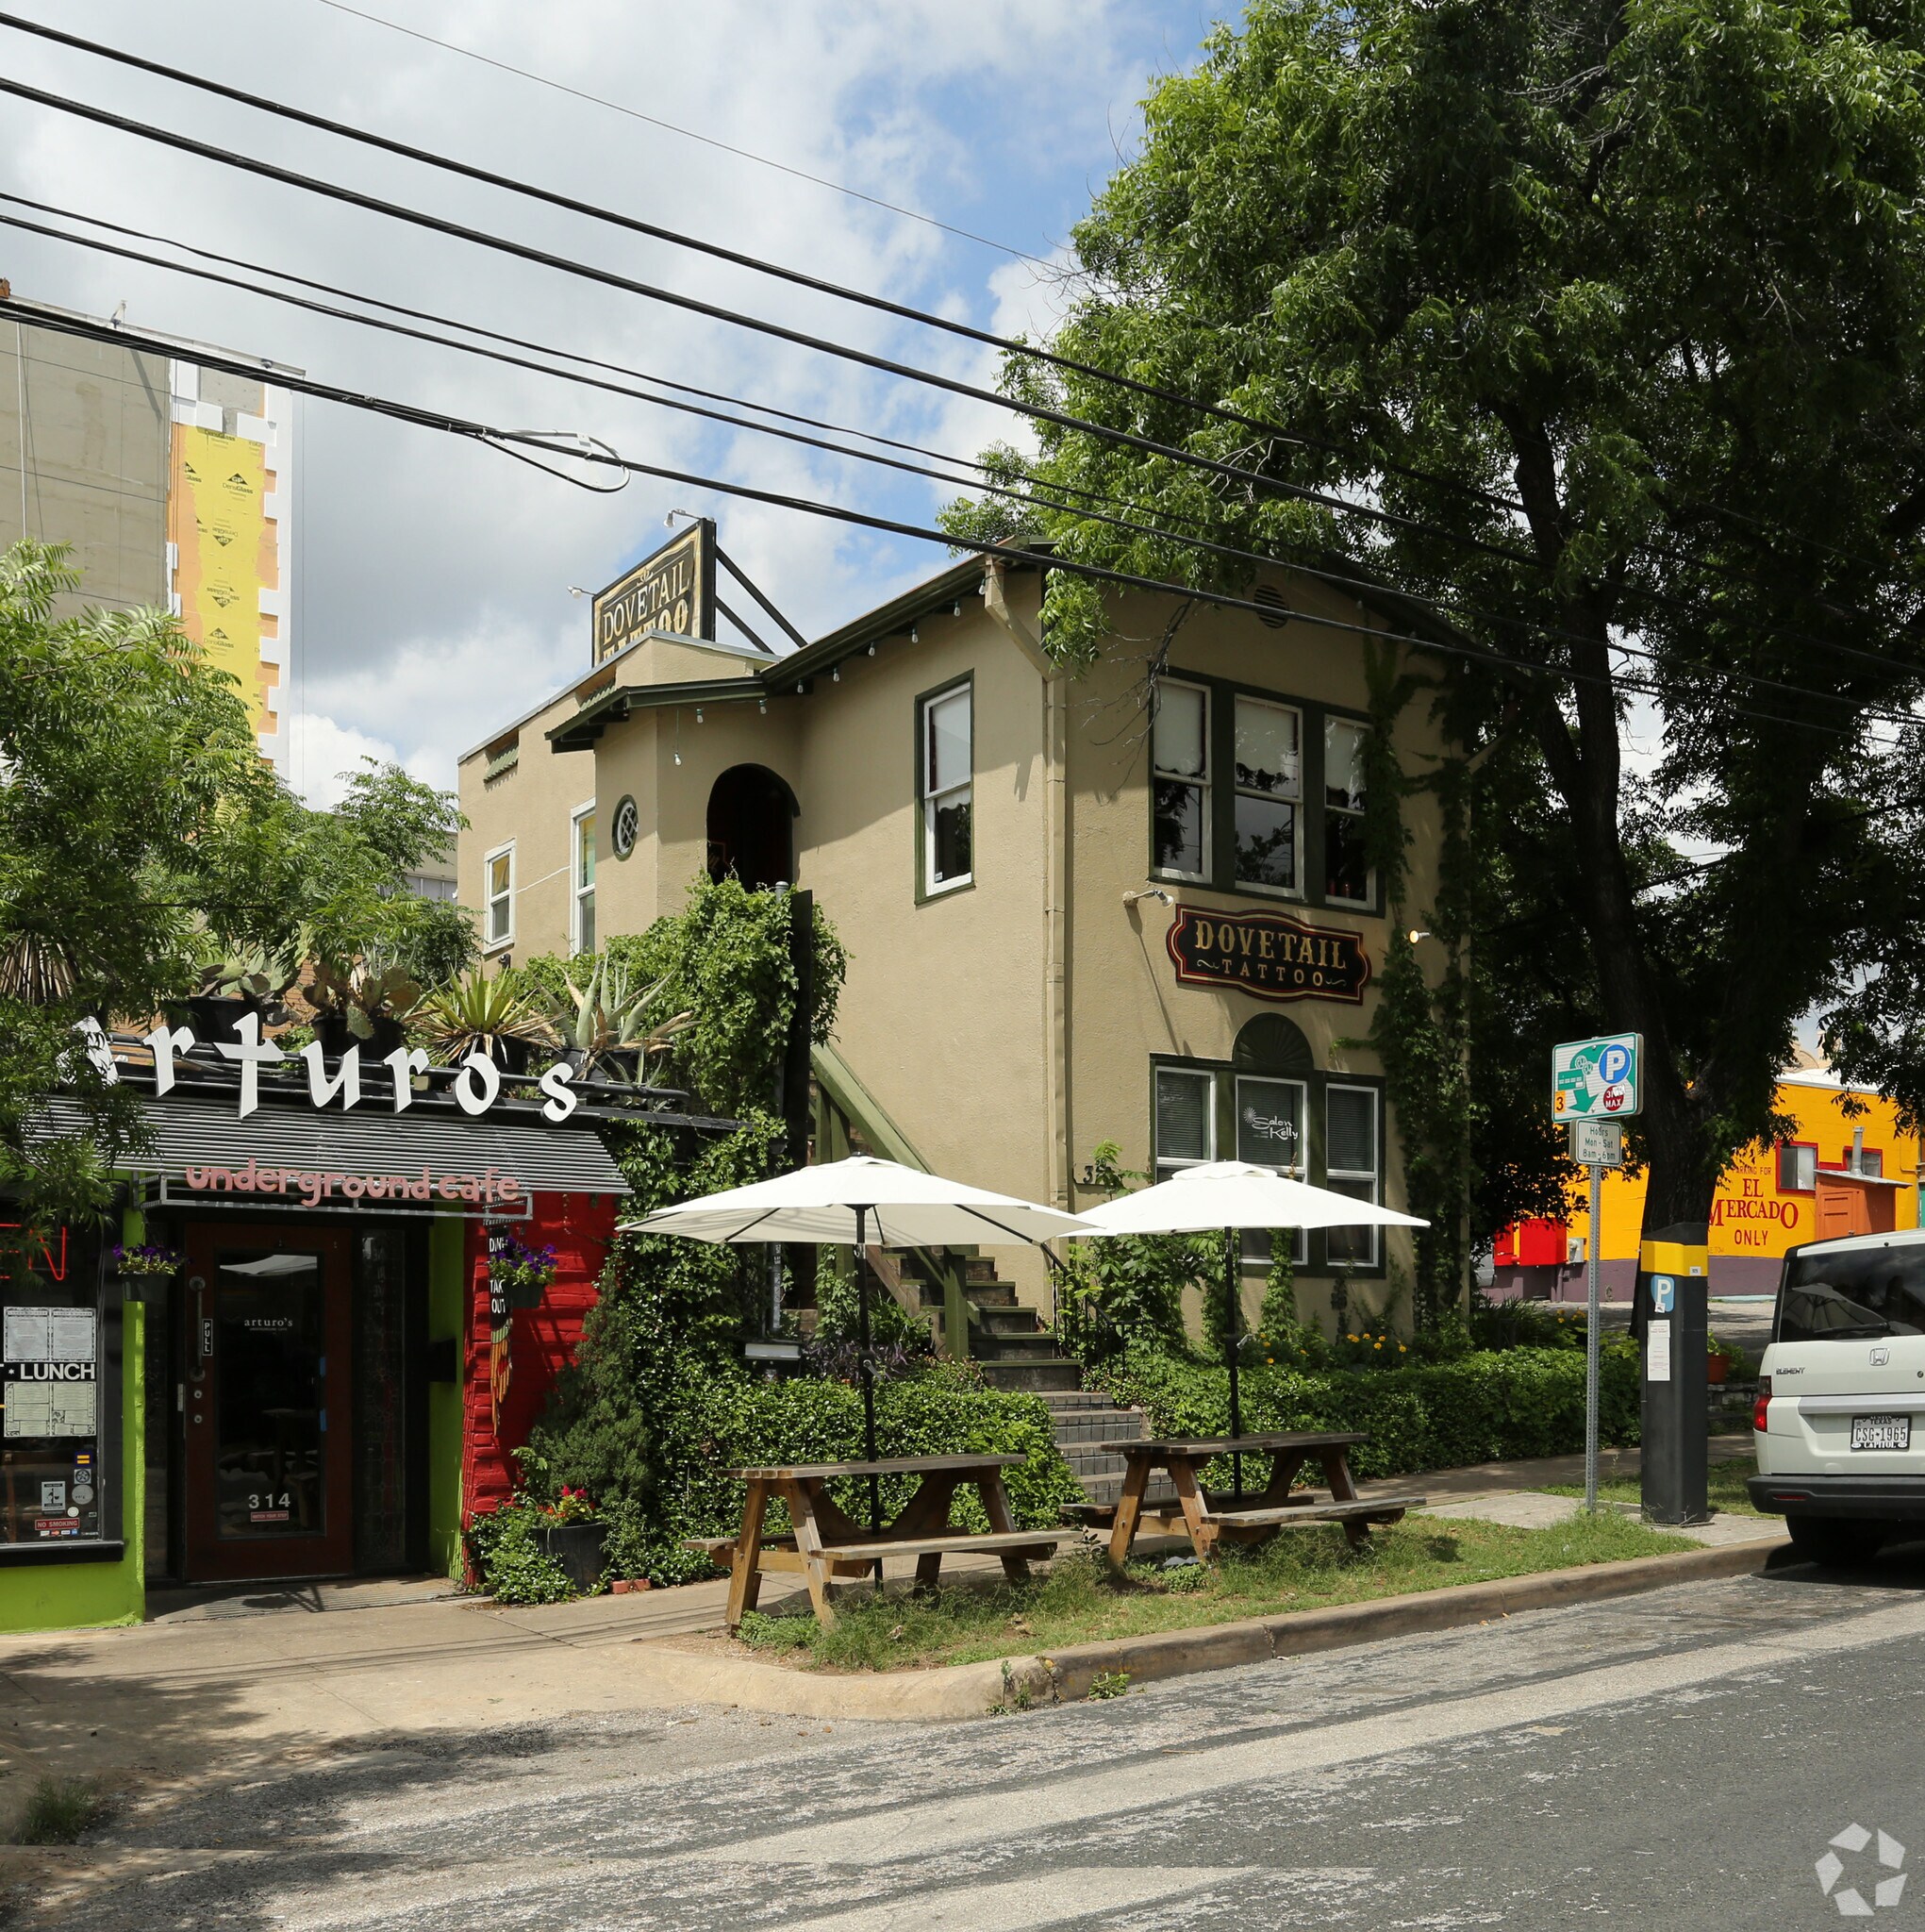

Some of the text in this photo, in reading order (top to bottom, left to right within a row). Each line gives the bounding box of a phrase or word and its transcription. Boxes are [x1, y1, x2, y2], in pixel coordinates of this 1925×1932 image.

[603, 559, 689, 646] DOVETAIL
[1194, 920, 1347, 970] DOVETAIL
[1221, 958, 1323, 987] TATTOO
[1605, 1049, 1626, 1081] P
[1556, 1096, 1564, 1111] 3
[1605, 1098, 1621, 1108] MAX
[1252, 1116, 1293, 1130] Salon
[1270, 1126, 1298, 1141] Kelly
[1590, 1126, 1608, 1137] Hours
[1585, 1138, 1597, 1147] Mon
[1602, 1138, 1613, 1148] Sat
[1583, 1149, 1597, 1158] 8am
[1602, 1150, 1616, 1160] 6pm
[1760, 1167, 1772, 1175] FOR
[186, 1158, 520, 1208] underground cafe
[1743, 1178, 1764, 1197] EL
[1708, 1199, 1799, 1229] MERCADO
[1734, 1229, 1768, 1246] ONLY
[1657, 1278, 1672, 1305] P
[491, 1298, 506, 1313] OUT
[244, 1317, 293, 1327] arturo's
[20, 1363, 94, 1380] LUNCH
[1776, 1367, 1805, 1375] ELEMENT
[248, 1492, 290, 1509] 314
